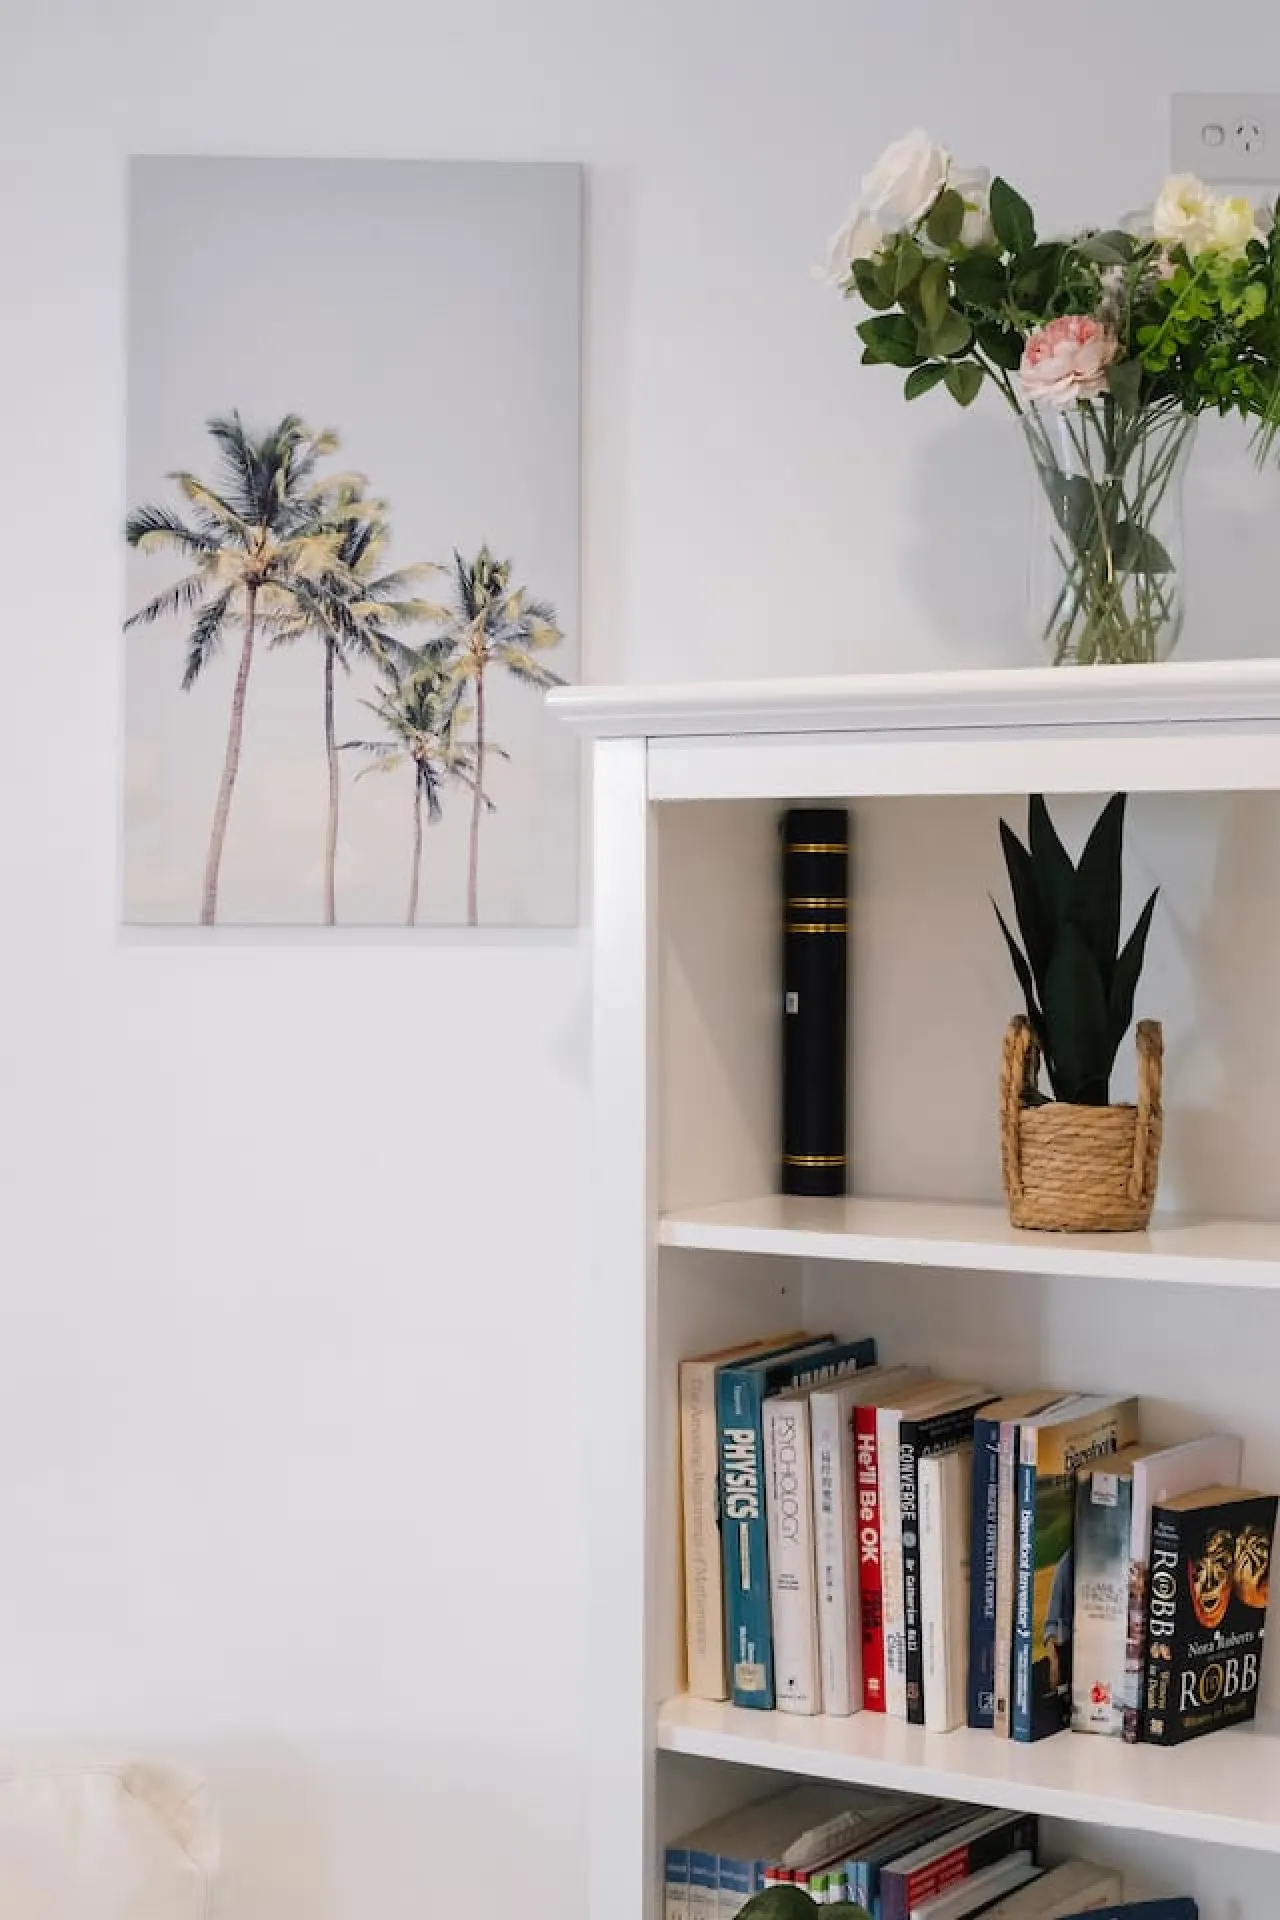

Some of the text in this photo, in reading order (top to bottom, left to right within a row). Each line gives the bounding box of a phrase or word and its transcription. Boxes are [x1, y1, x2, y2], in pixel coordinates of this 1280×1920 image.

[723, 1428, 759, 1520] PHYSICS
[779, 1415, 799, 1546] PSYCHOLOGY
[857, 1433, 879, 1564] He'll Be OK
[900, 1443, 917, 1521] CONVERGE
[1150, 1550, 1179, 1637] ROBB
[1179, 1653, 1257, 1713] ROBB
